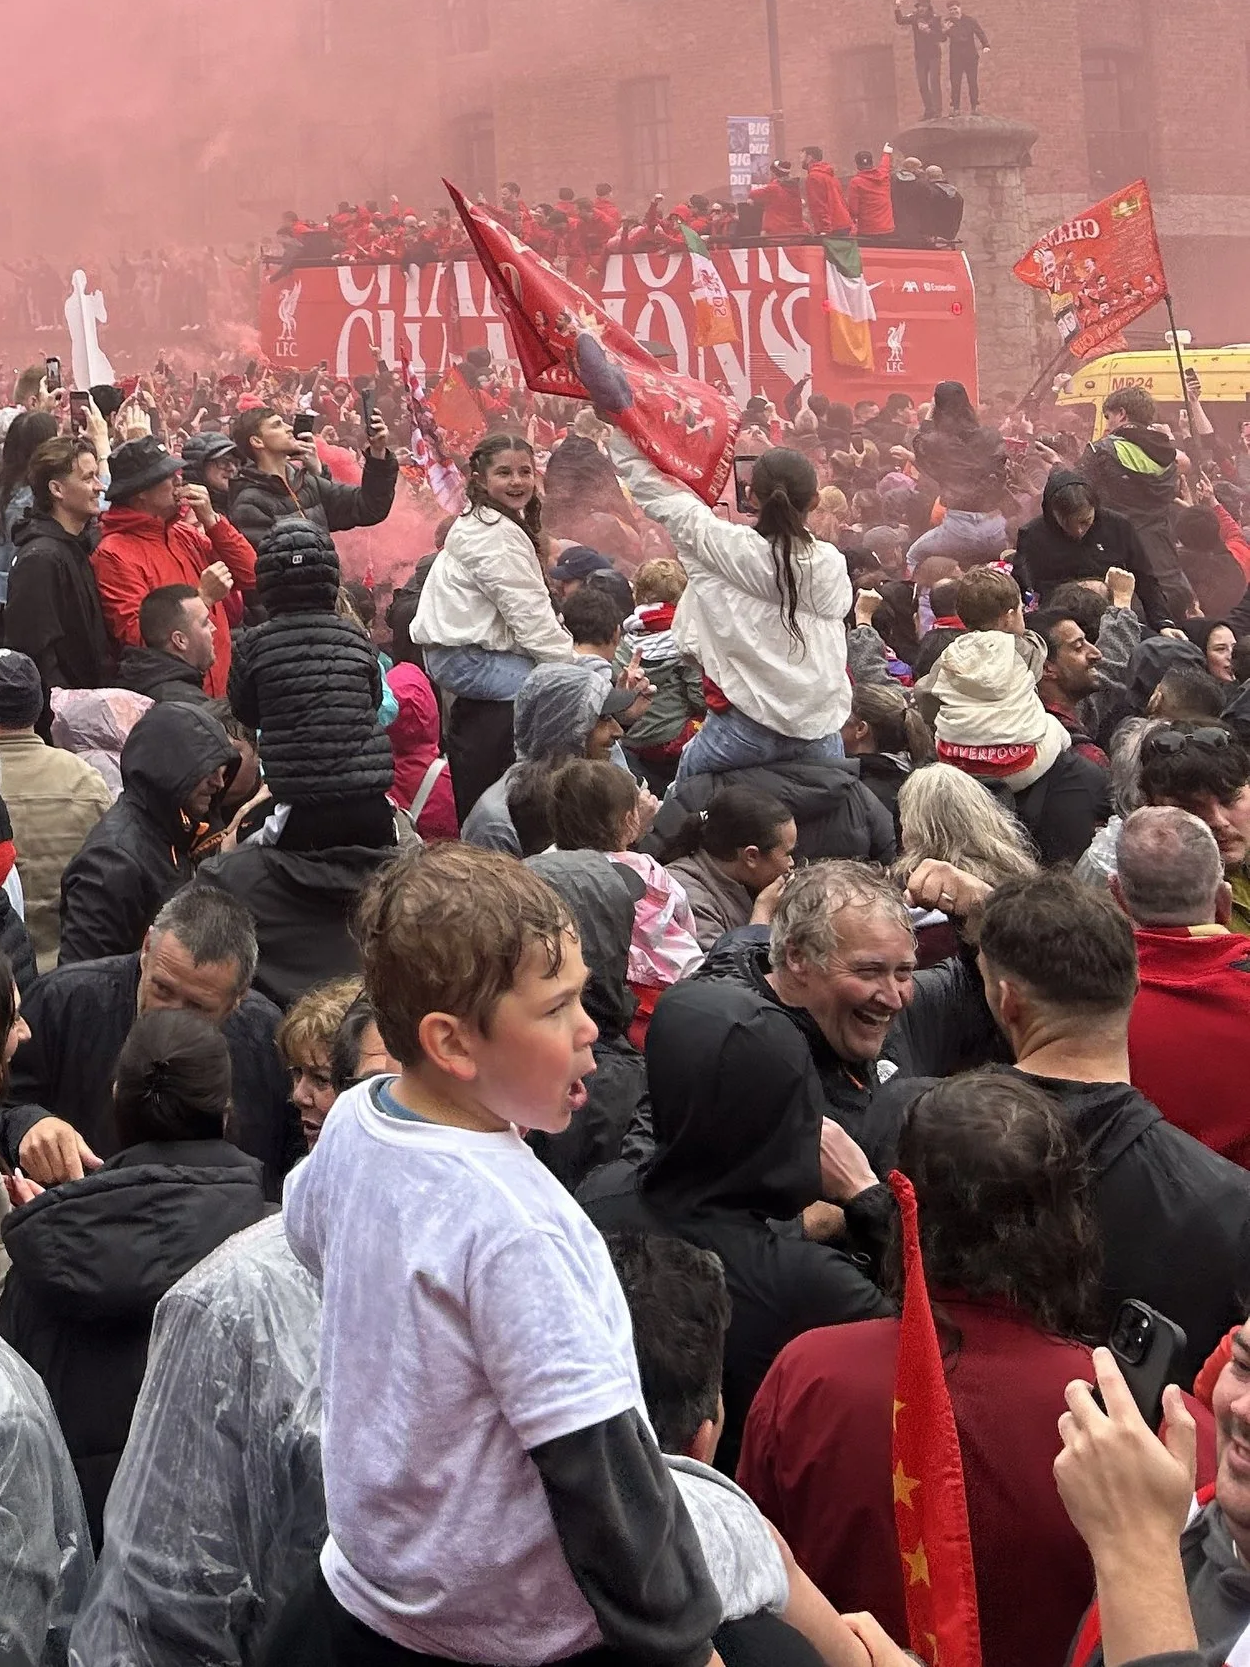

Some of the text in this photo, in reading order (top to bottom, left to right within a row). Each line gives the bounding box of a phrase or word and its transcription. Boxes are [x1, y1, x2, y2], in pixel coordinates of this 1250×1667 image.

[728, 153, 750, 166] BIG
[275, 341, 298, 357] LFC
[886, 361, 905, 372] LFC
